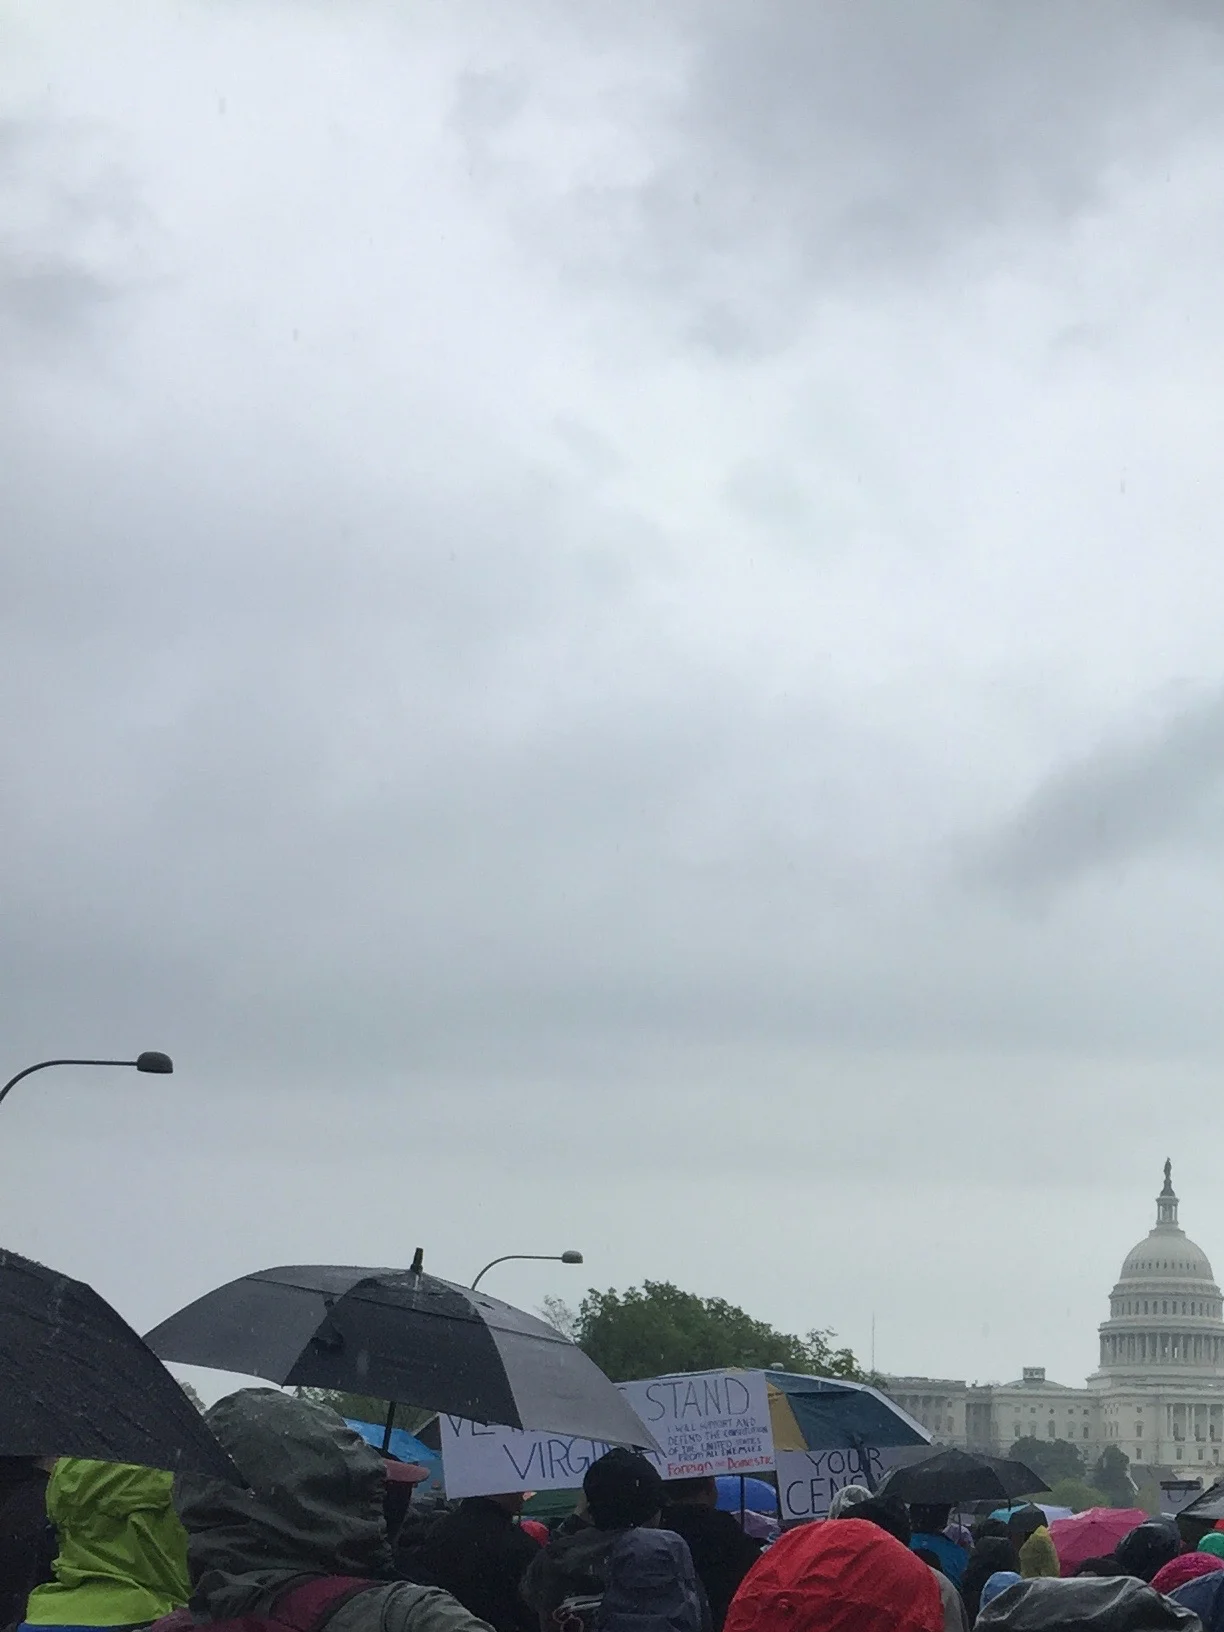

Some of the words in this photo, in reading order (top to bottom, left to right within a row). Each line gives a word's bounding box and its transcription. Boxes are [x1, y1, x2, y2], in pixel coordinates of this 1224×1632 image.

[646, 1377, 750, 1421] STAND
[736, 1417, 756, 1427] AND
[668, 1434, 702, 1446] DEFEND
[705, 1430, 720, 1440] THE
[668, 1447, 678, 1456] OF
[700, 1440, 732, 1452] UNITED
[678, 1451, 704, 1462] FROM
[705, 1450, 718, 1459] ALL
[721, 1445, 762, 1457] ENEMIES
[502, 1436, 661, 1480] VIRGI
[805, 1447, 884, 1476] YOUR
